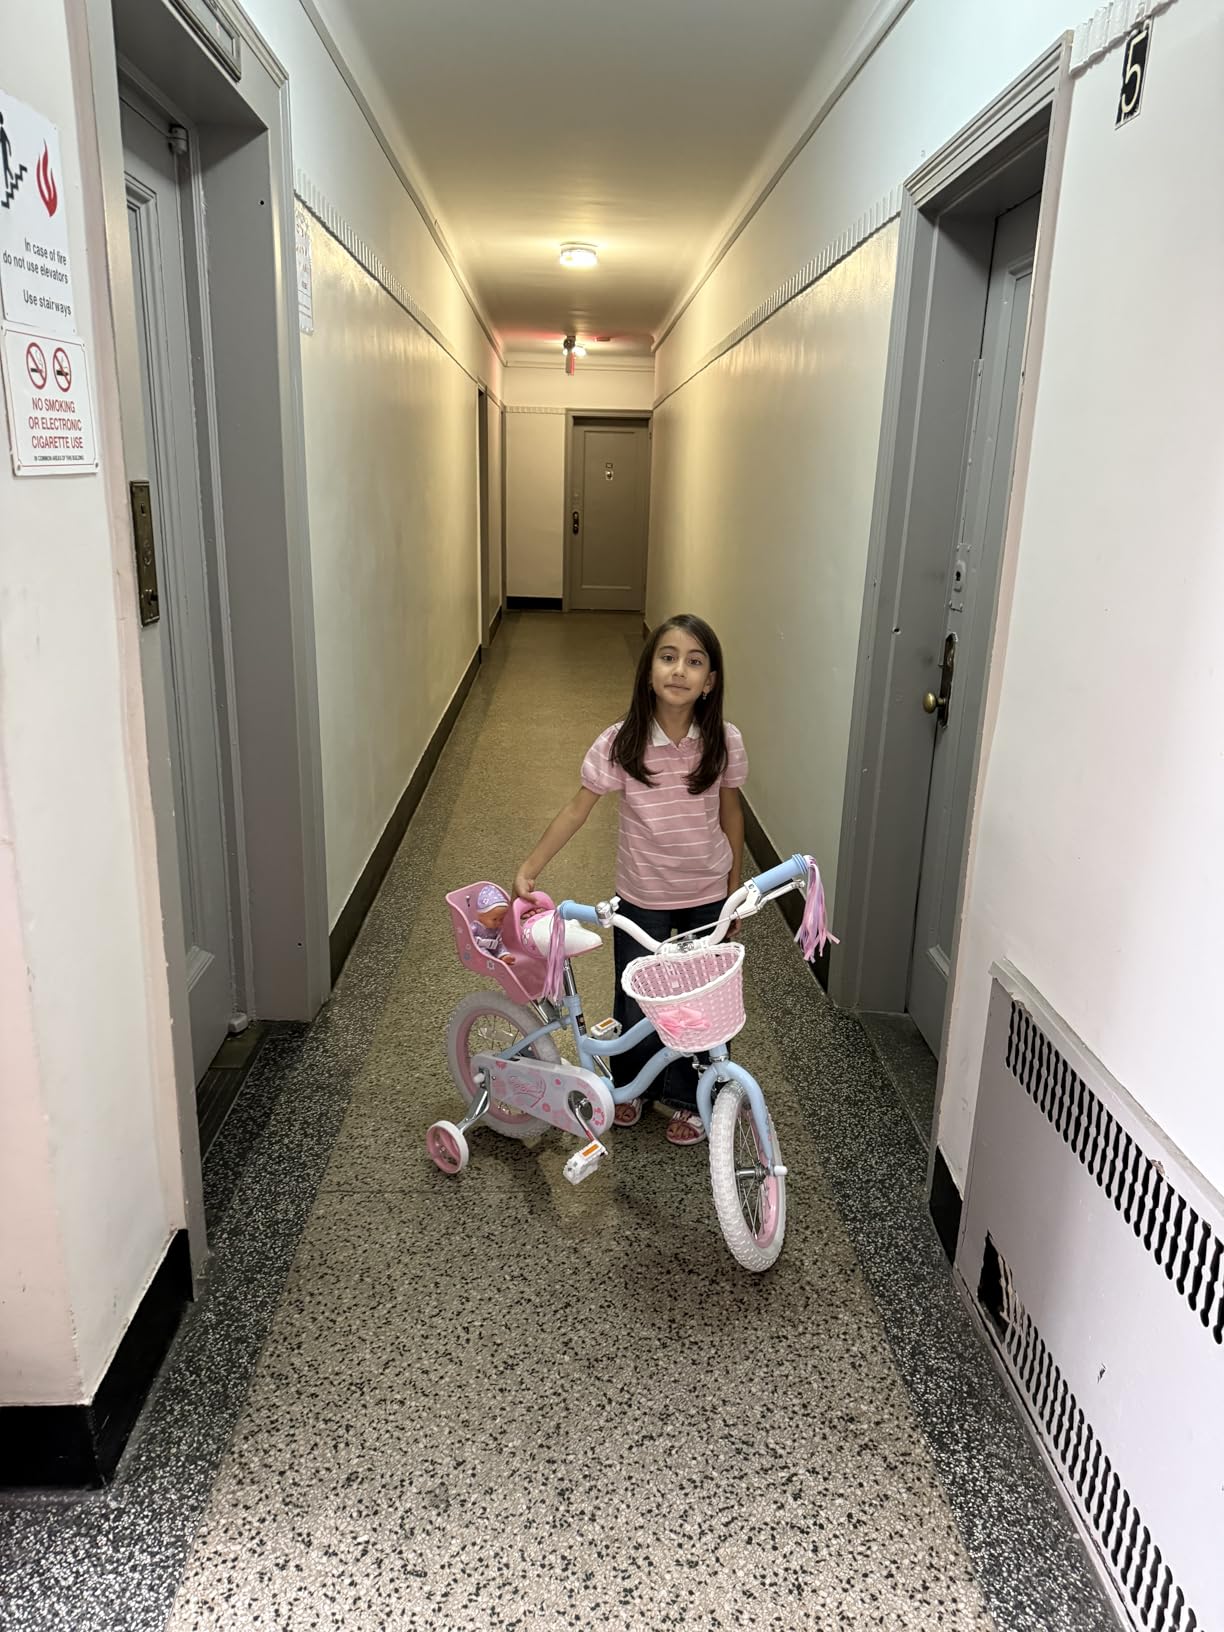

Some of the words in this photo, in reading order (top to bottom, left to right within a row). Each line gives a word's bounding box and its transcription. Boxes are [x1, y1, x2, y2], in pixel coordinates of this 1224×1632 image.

[1121, 30, 1148, 113] 5
[24, 236, 31, 252] In
[32, 243, 48, 259] case
[49, 248, 56, 262] of
[56, 250, 67, 266] fire
[2, 249, 12, 265] do
[13, 256, 25, 270] not
[26, 260, 39, 274] use
[40, 264, 68, 284] elevators
[23, 288, 38, 306] Use
[39, 296, 71, 317] stairways
[32, 397, 43, 411] NO
[44, 398, 75, 413] SMOKING
[28, 416, 40, 430] OR
[41, 417, 82, 432] ELECTRONIC
[31, 435, 70, 449] CIGARETTE
[70, 436, 84, 449] USE
